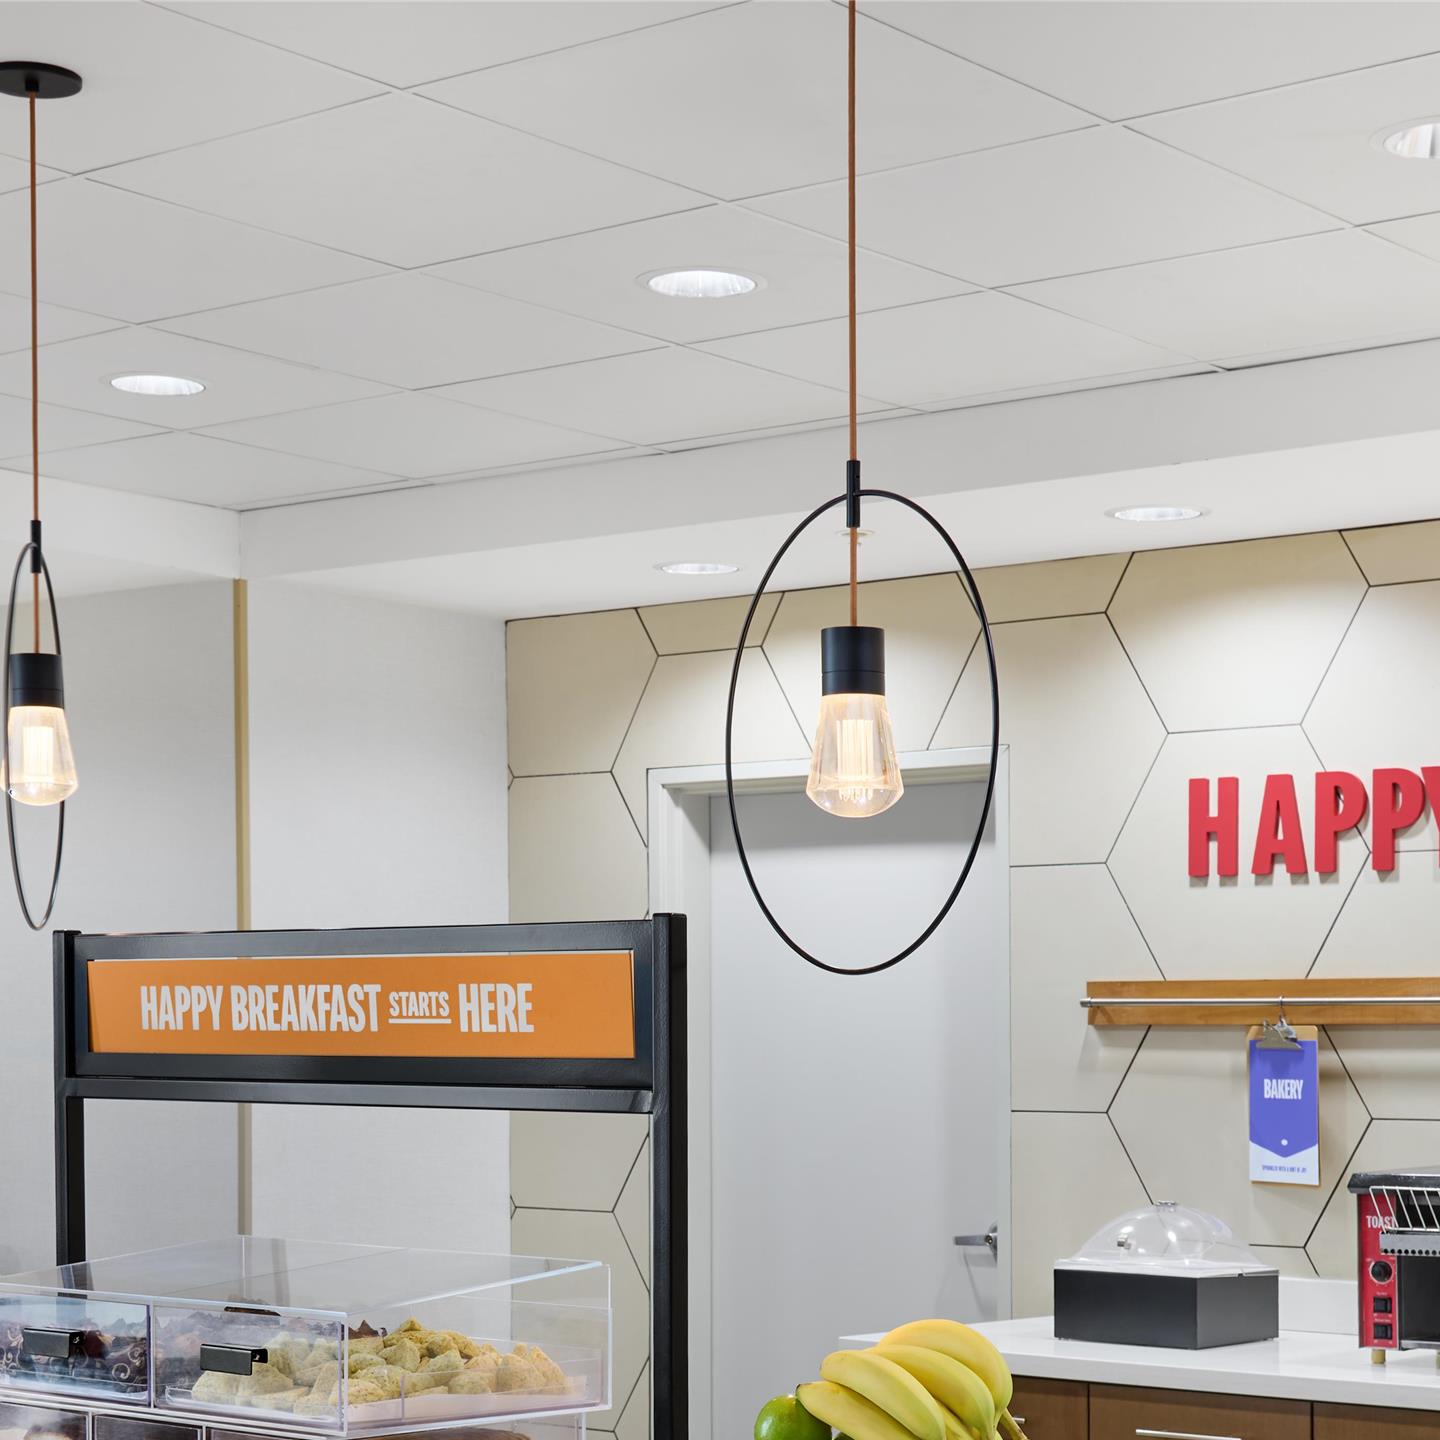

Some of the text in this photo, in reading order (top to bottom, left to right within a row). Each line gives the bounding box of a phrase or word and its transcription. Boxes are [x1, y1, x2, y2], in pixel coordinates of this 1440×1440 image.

[140, 983, 535, 1033] HAPPY BREAKFAST STARTS HERE
[1263, 1079, 1304, 1100] BAKERY
[1366, 1215, 1397, 1229] TOAST
